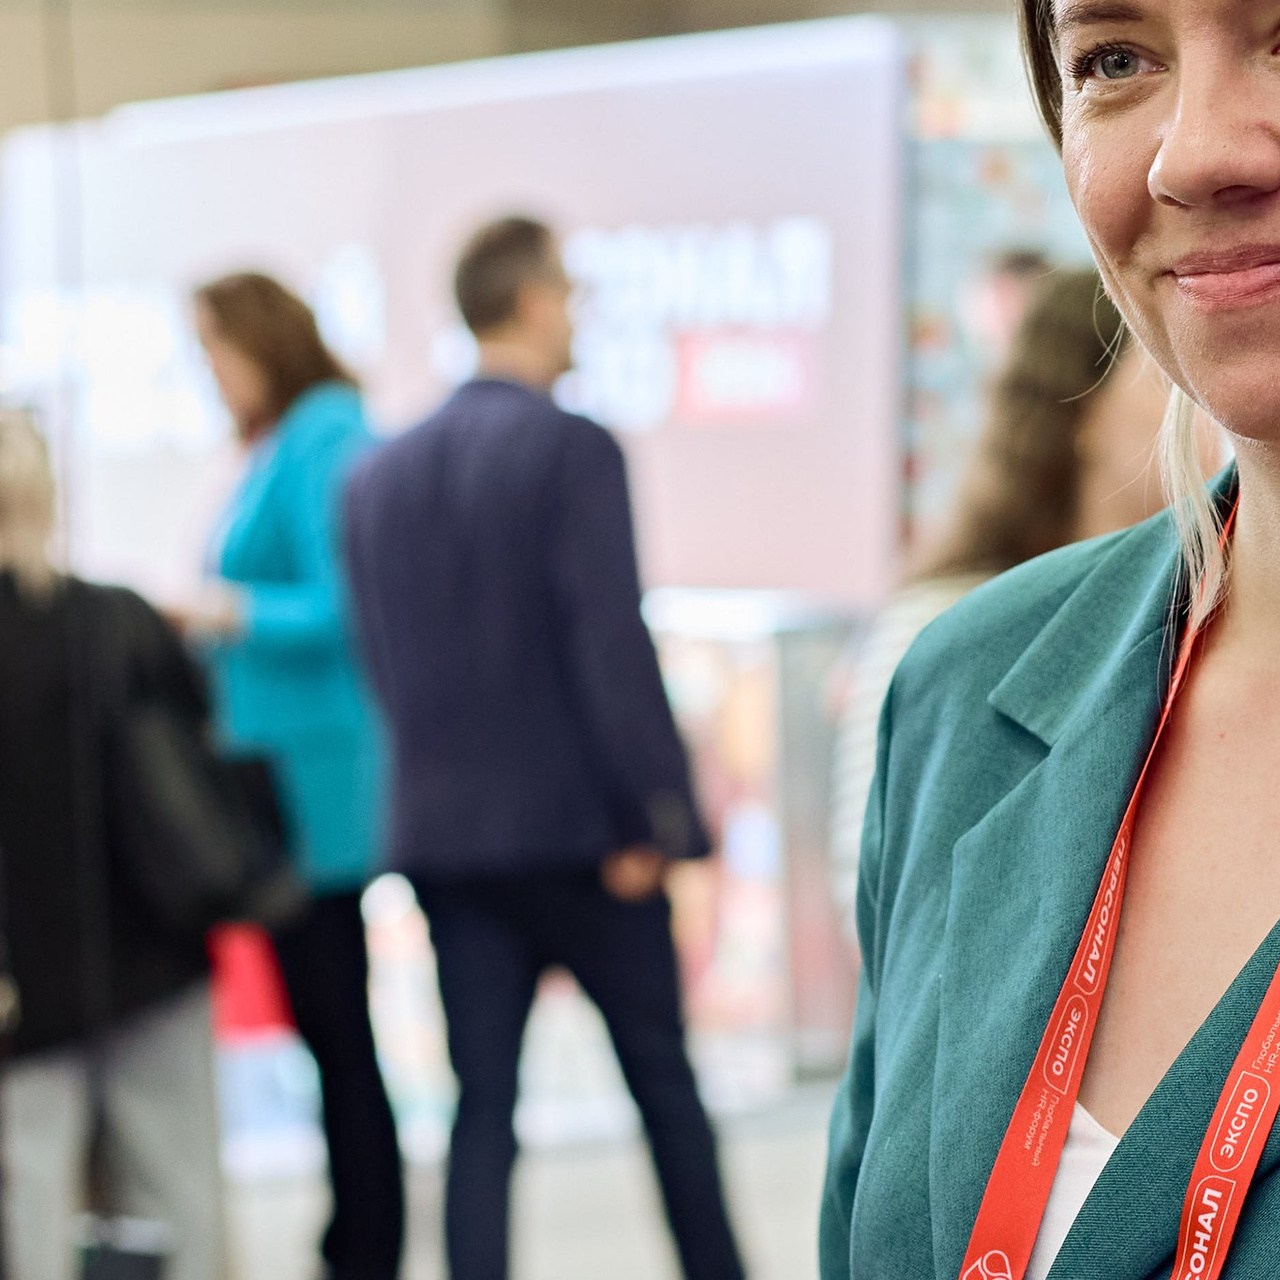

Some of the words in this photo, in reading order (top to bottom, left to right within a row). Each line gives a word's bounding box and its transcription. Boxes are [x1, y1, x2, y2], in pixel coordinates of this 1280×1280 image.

[1083, 837, 1126, 984] ПЕРСОНАЛ
[1052, 1007, 1082, 1076] ЭКСПО
[1024, 1087, 1050, 1150] HR-форум
[1031, 1094, 1061, 1167] Глобальный
[1220, 1088, 1259, 1158] ЭКСПО
